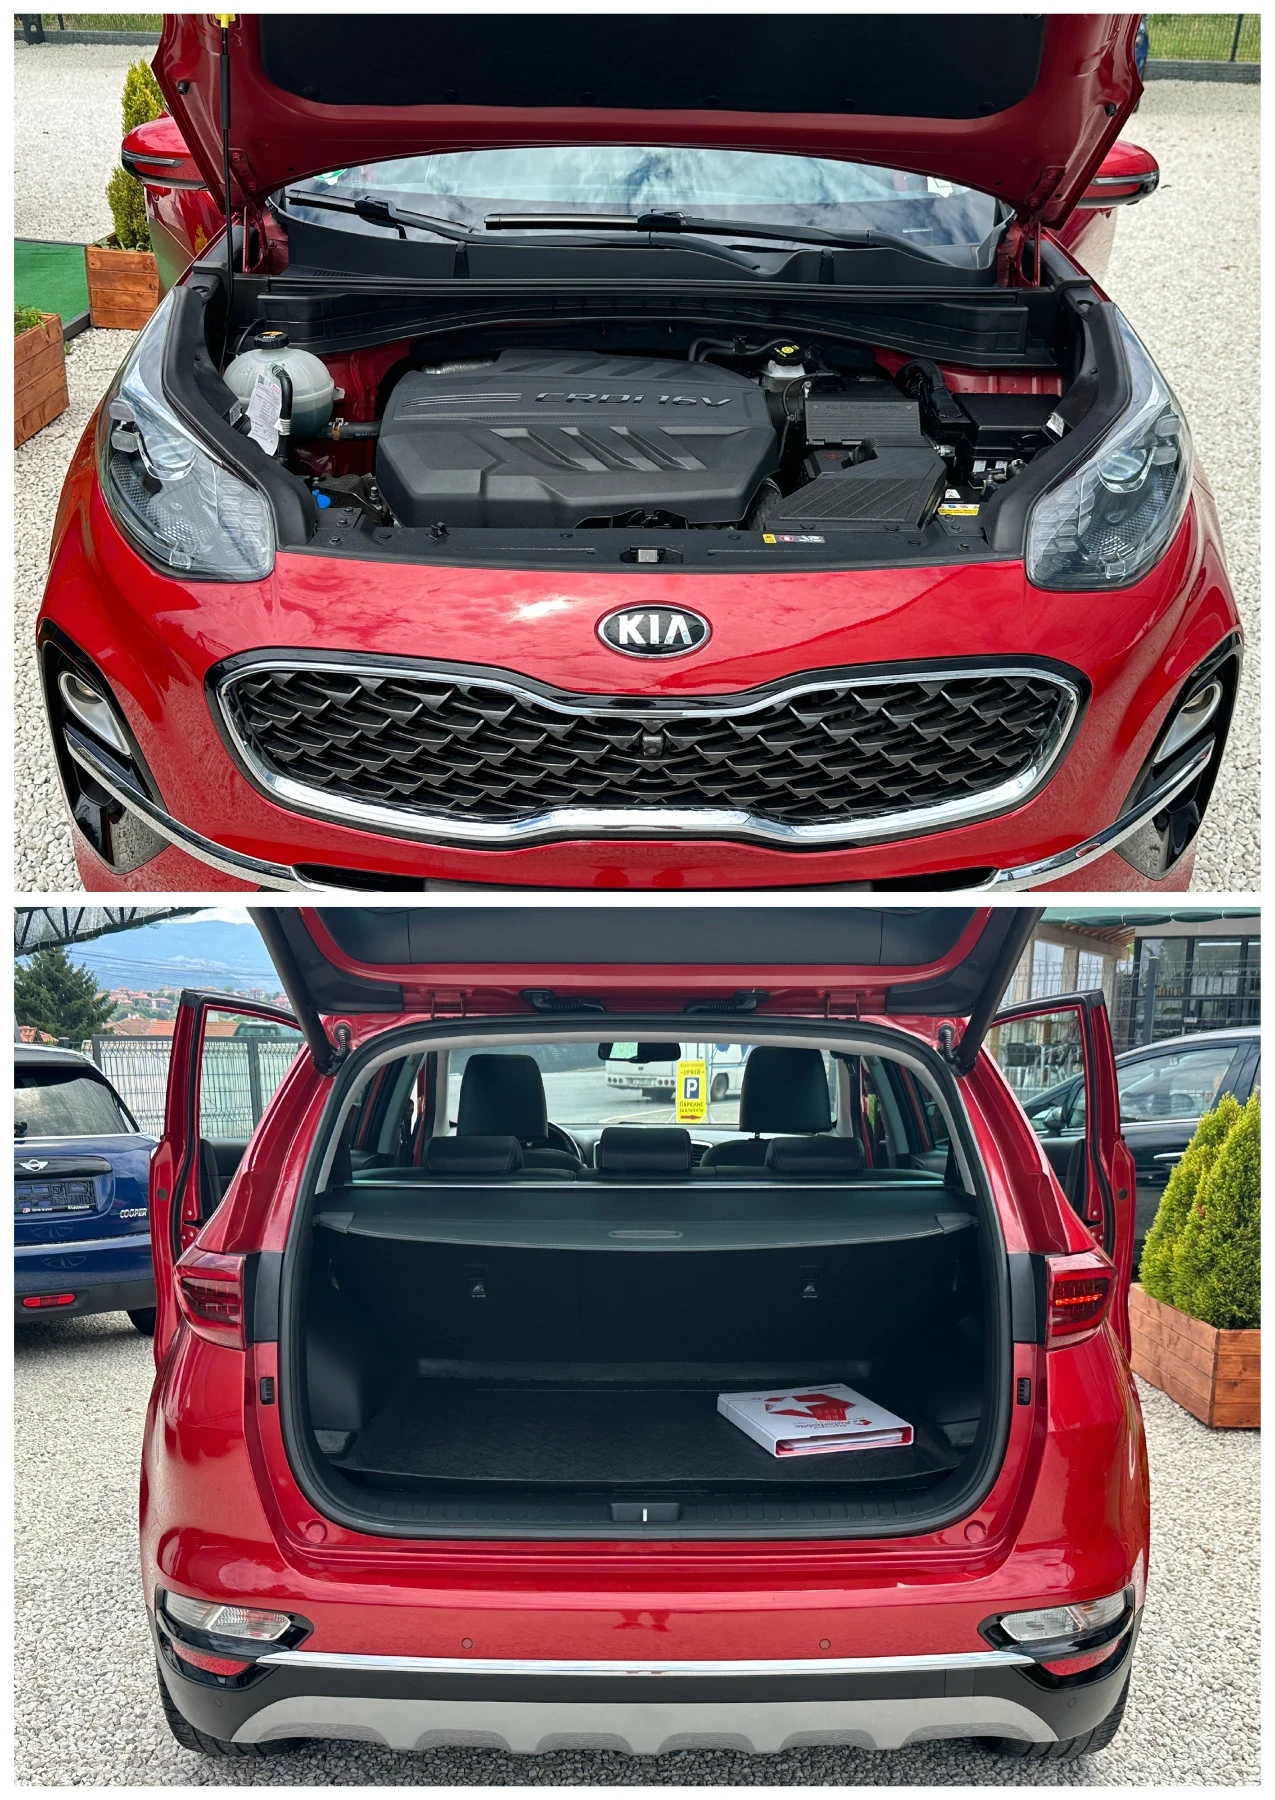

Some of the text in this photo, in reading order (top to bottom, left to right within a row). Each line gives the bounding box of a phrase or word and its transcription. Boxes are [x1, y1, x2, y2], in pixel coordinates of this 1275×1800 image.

[535, 393, 732, 408] CRDi 16V
[618, 614, 693, 645] KIA
[686, 1078, 698, 1099] P
[120, 1207, 148, 1219] COOPER
